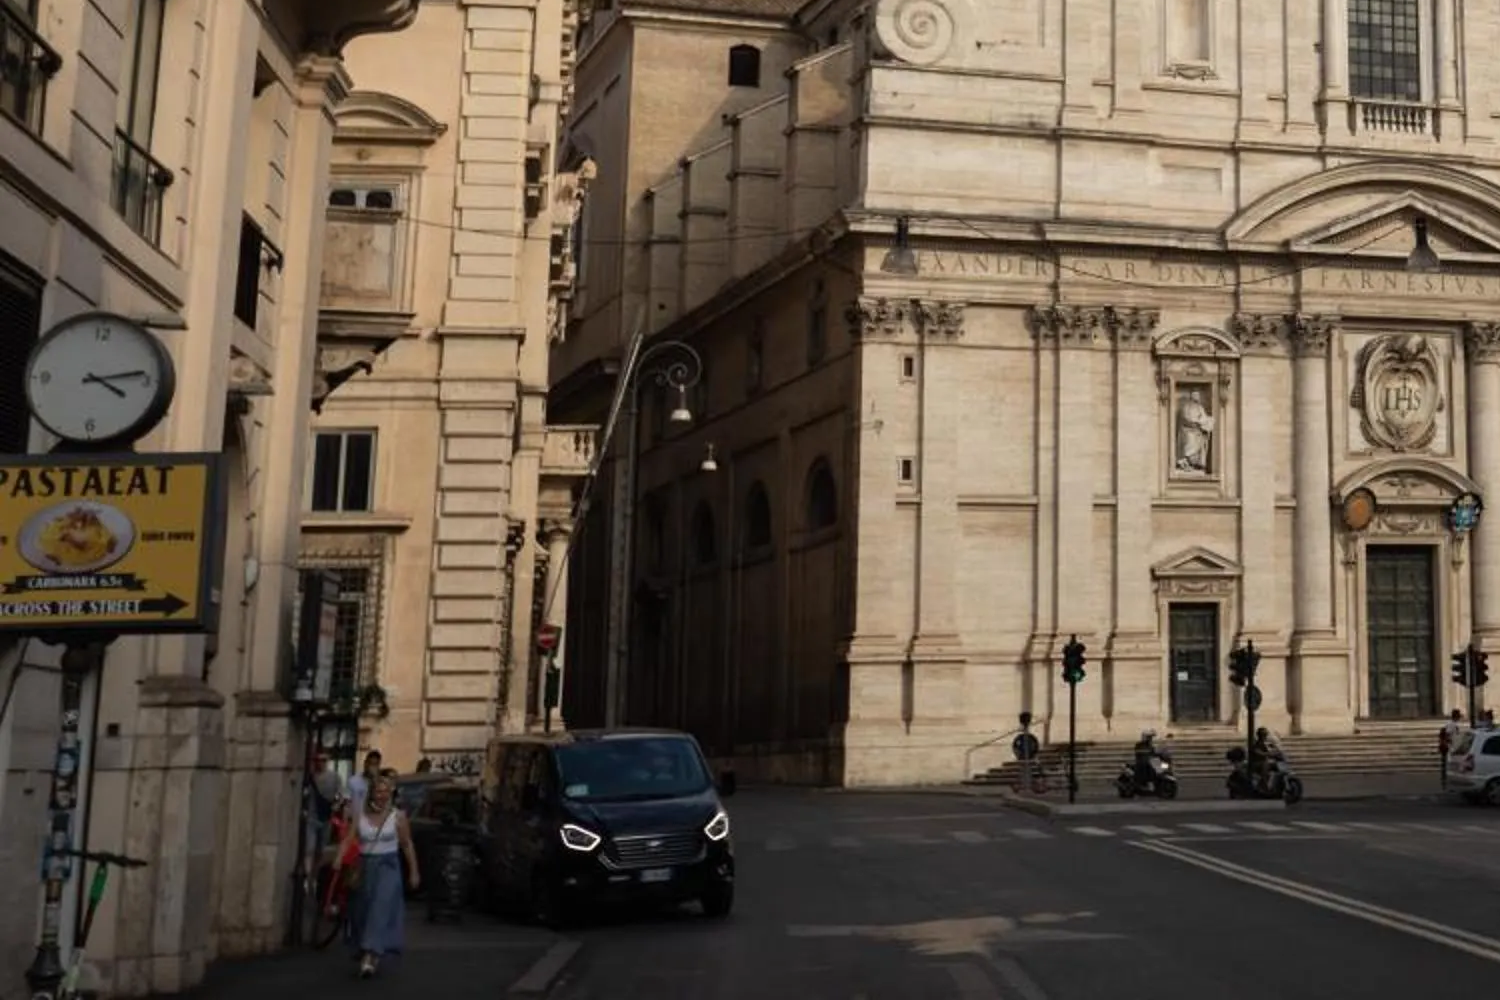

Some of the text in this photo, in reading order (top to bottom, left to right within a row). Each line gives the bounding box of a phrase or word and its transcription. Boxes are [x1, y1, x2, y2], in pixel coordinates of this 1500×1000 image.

[1320, 268, 1486, 295] FARNESIVS
[95, 326, 111, 341] 12
[1385, 387, 1421, 411] IHS
[84, 417, 96, 432] 6
[59, 601, 83, 616] THE
[91, 600, 140, 615] STREET
